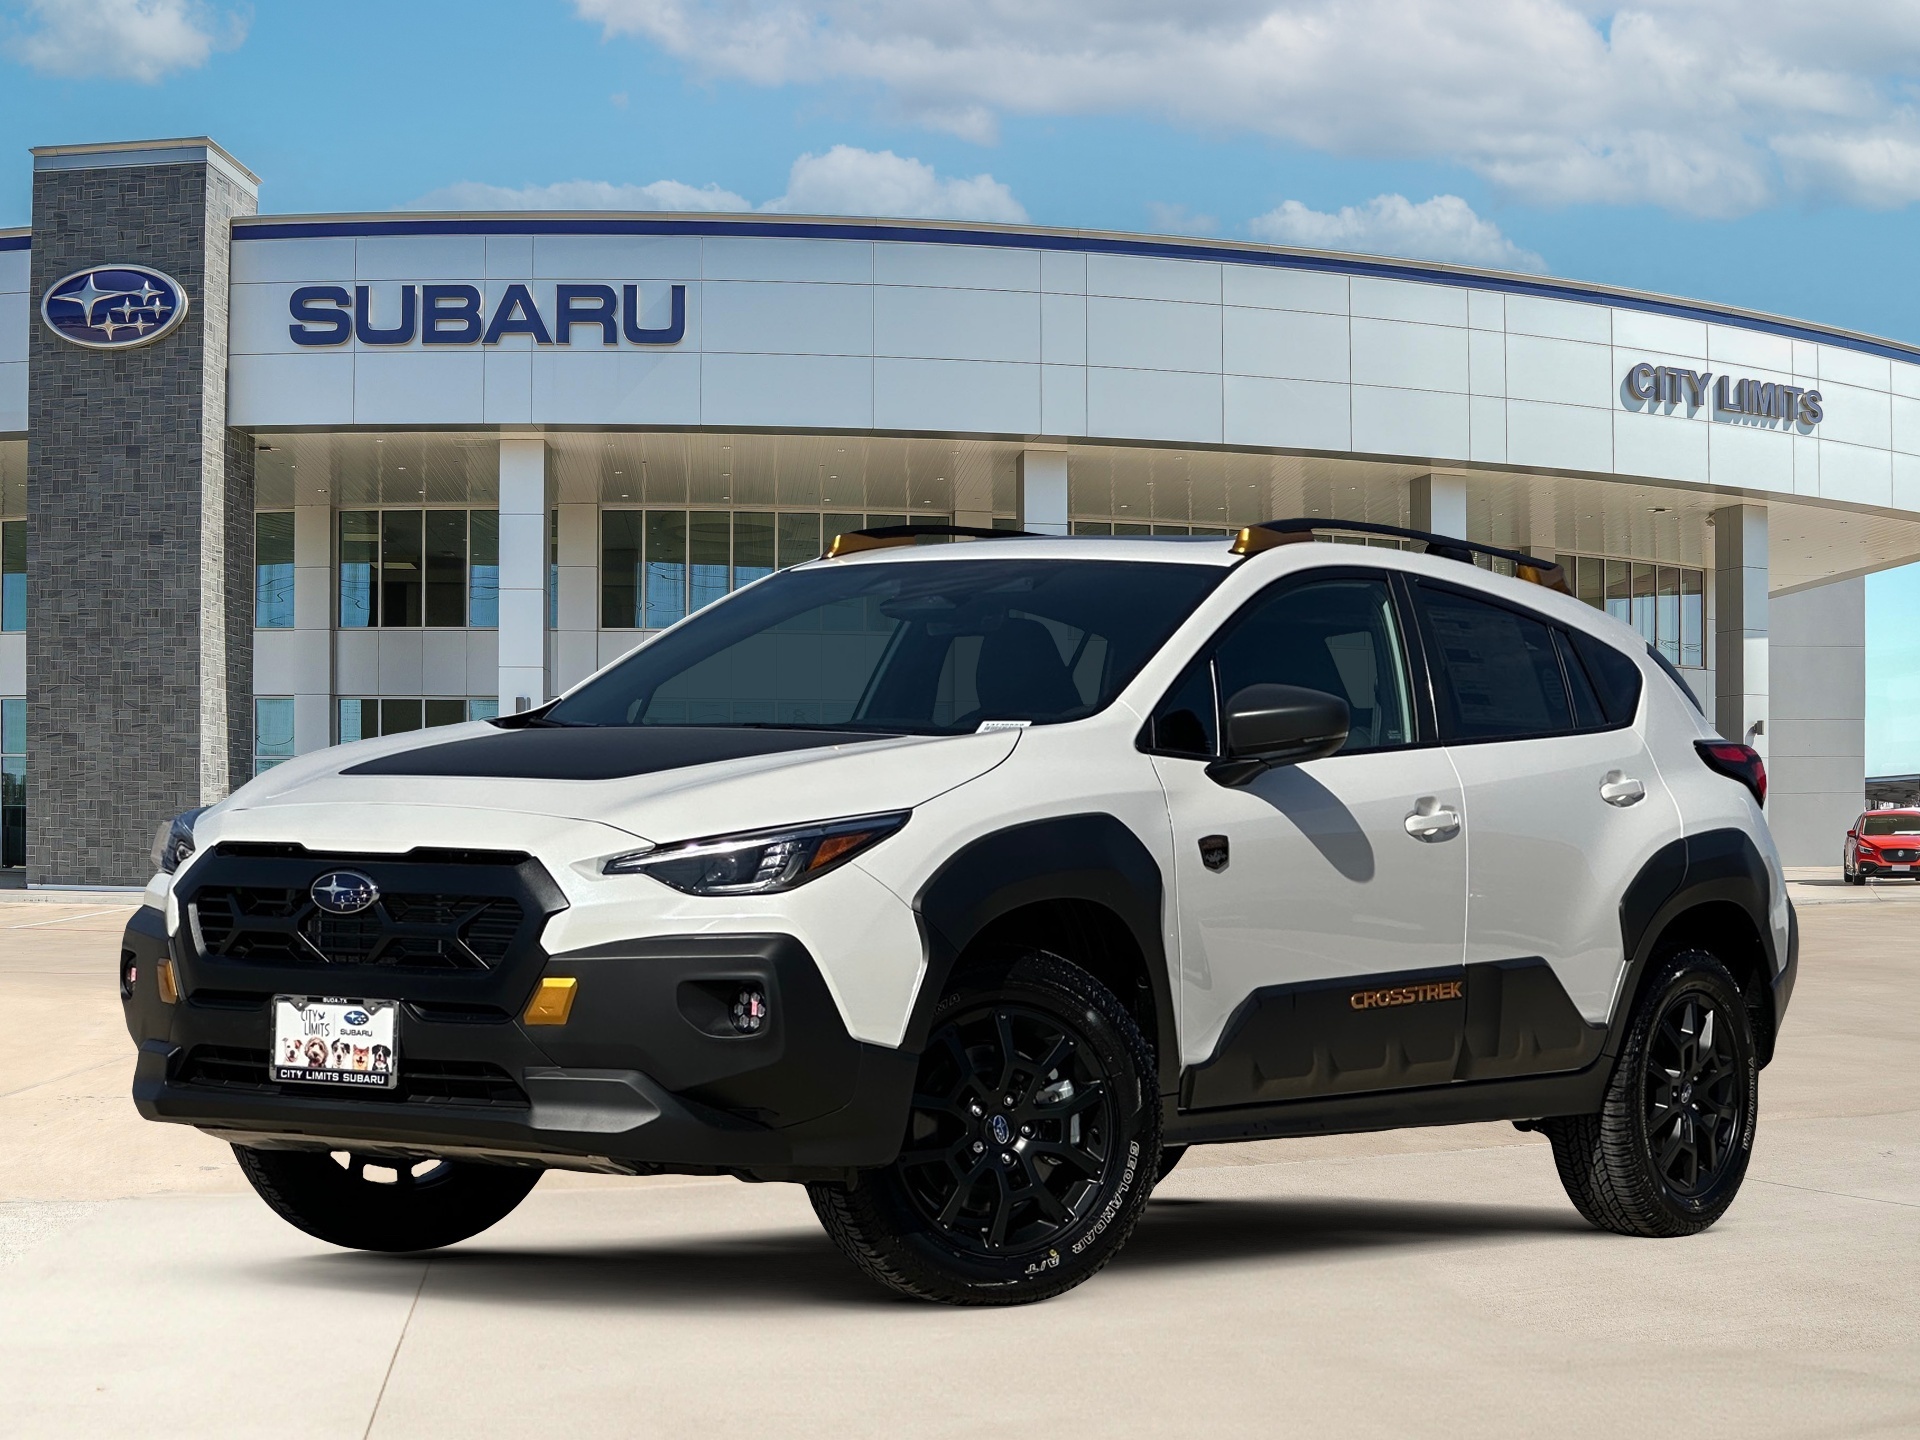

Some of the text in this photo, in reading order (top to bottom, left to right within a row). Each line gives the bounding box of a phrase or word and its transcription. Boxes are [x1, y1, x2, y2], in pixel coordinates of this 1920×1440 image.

[289, 283, 687, 346] SUBARU
[1629, 362, 1824, 425] CITY LIMITS
[1351, 981, 1462, 1009] CROSSTREK
[301, 1009, 319, 1022] CITY
[304, 1022, 331, 1037] LIMITS
[340, 1028, 373, 1037] SUBARU
[280, 1069, 385, 1084] CITY LIMITS SUBARU
[1025, 1140, 1140, 1274] GEOLANDAR A/T
